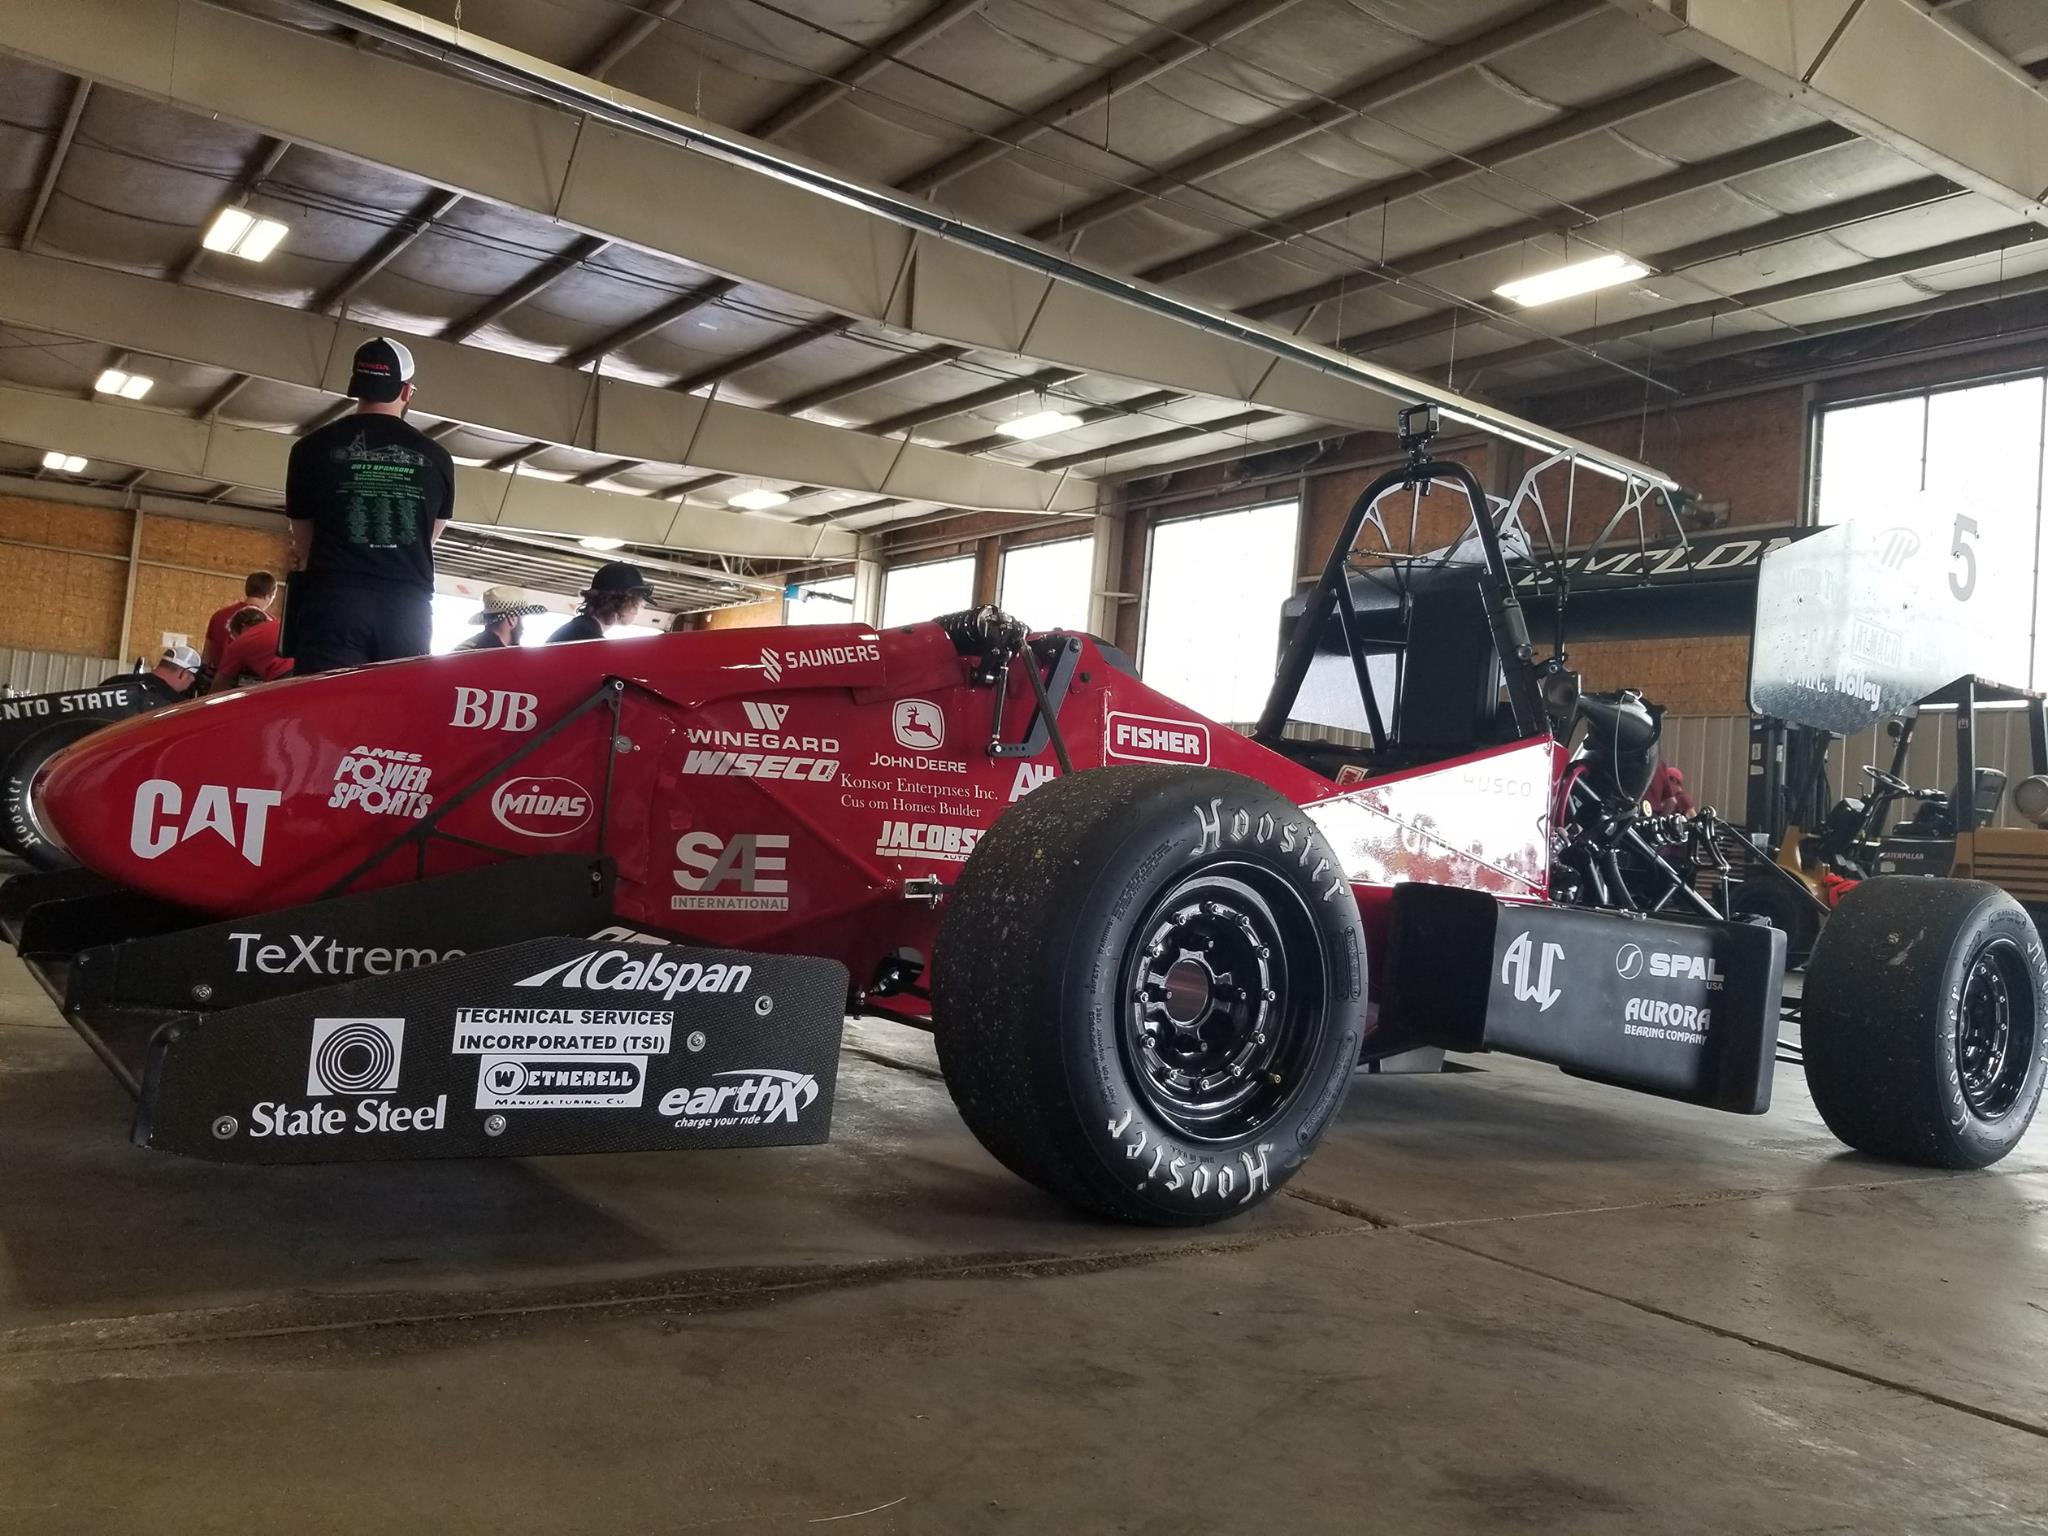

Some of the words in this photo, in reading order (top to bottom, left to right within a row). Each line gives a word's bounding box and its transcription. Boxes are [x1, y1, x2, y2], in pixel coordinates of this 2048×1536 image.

[1948, 512, 1976, 602] 5
[785, 645, 880, 669] SAUNDERS
[1835, 666, 1881, 712] Holley
[0, 699, 49, 721] NTO
[60, 689, 128, 713] STATE
[449, 686, 538, 732] BJB
[350, 745, 423, 762] AMES
[688, 728, 840, 753] WINEGARD
[1117, 724, 1199, 754] FISHER
[334, 756, 432, 793] POWER
[682, 750, 840, 782] WISECO
[870, 752, 914, 768] JOHN
[916, 755, 967, 774] DEERE
[501, 785, 586, 816] MIDAS
[840, 773, 893, 791] Konsor
[897, 778, 970, 799] Enterprises
[974, 785, 998, 801] Inc.
[1463, 773, 1533, 797] HUSCO
[9, 776, 42, 848] Hoosier
[328, 783, 433, 819] SPORTS
[841, 794, 889, 809] Cusom
[893, 798, 936, 813] Homes
[940, 801, 981, 817] Builder
[131, 779, 282, 867] CAT
[876, 821, 987, 854] JACOBS
[673, 831, 790, 893] SAE
[1190, 797, 1345, 902] Hoosier
[673, 897, 787, 910] INTERNATIONAL
[586, 950, 751, 1000] Calspan
[1650, 952, 1725, 982] SPAL
[1705, 981, 1723, 991] USA
[457, 1009, 574, 1024] TECHNICAL
[580, 1011, 672, 1025] SERVICES
[1624, 997, 1711, 1031] AURORA
[460, 1035, 617, 1049] INCORPORATED
[622, 1036, 665, 1052] (TSI)
[1624, 1024, 1664, 1040] BEARING
[1666, 1030, 1707, 1046] COMPANY
[494, 1070, 633, 1087] WETHERELL
[658, 1074, 815, 1123] earthX
[250, 1102, 346, 1137] State
[354, 1094, 447, 1134] Steel
[674, 1117, 711, 1130] charge
[713, 1116, 737, 1128] your
[739, 1114, 761, 1125] ride
[1107, 1109, 1274, 1204] Hoosier
